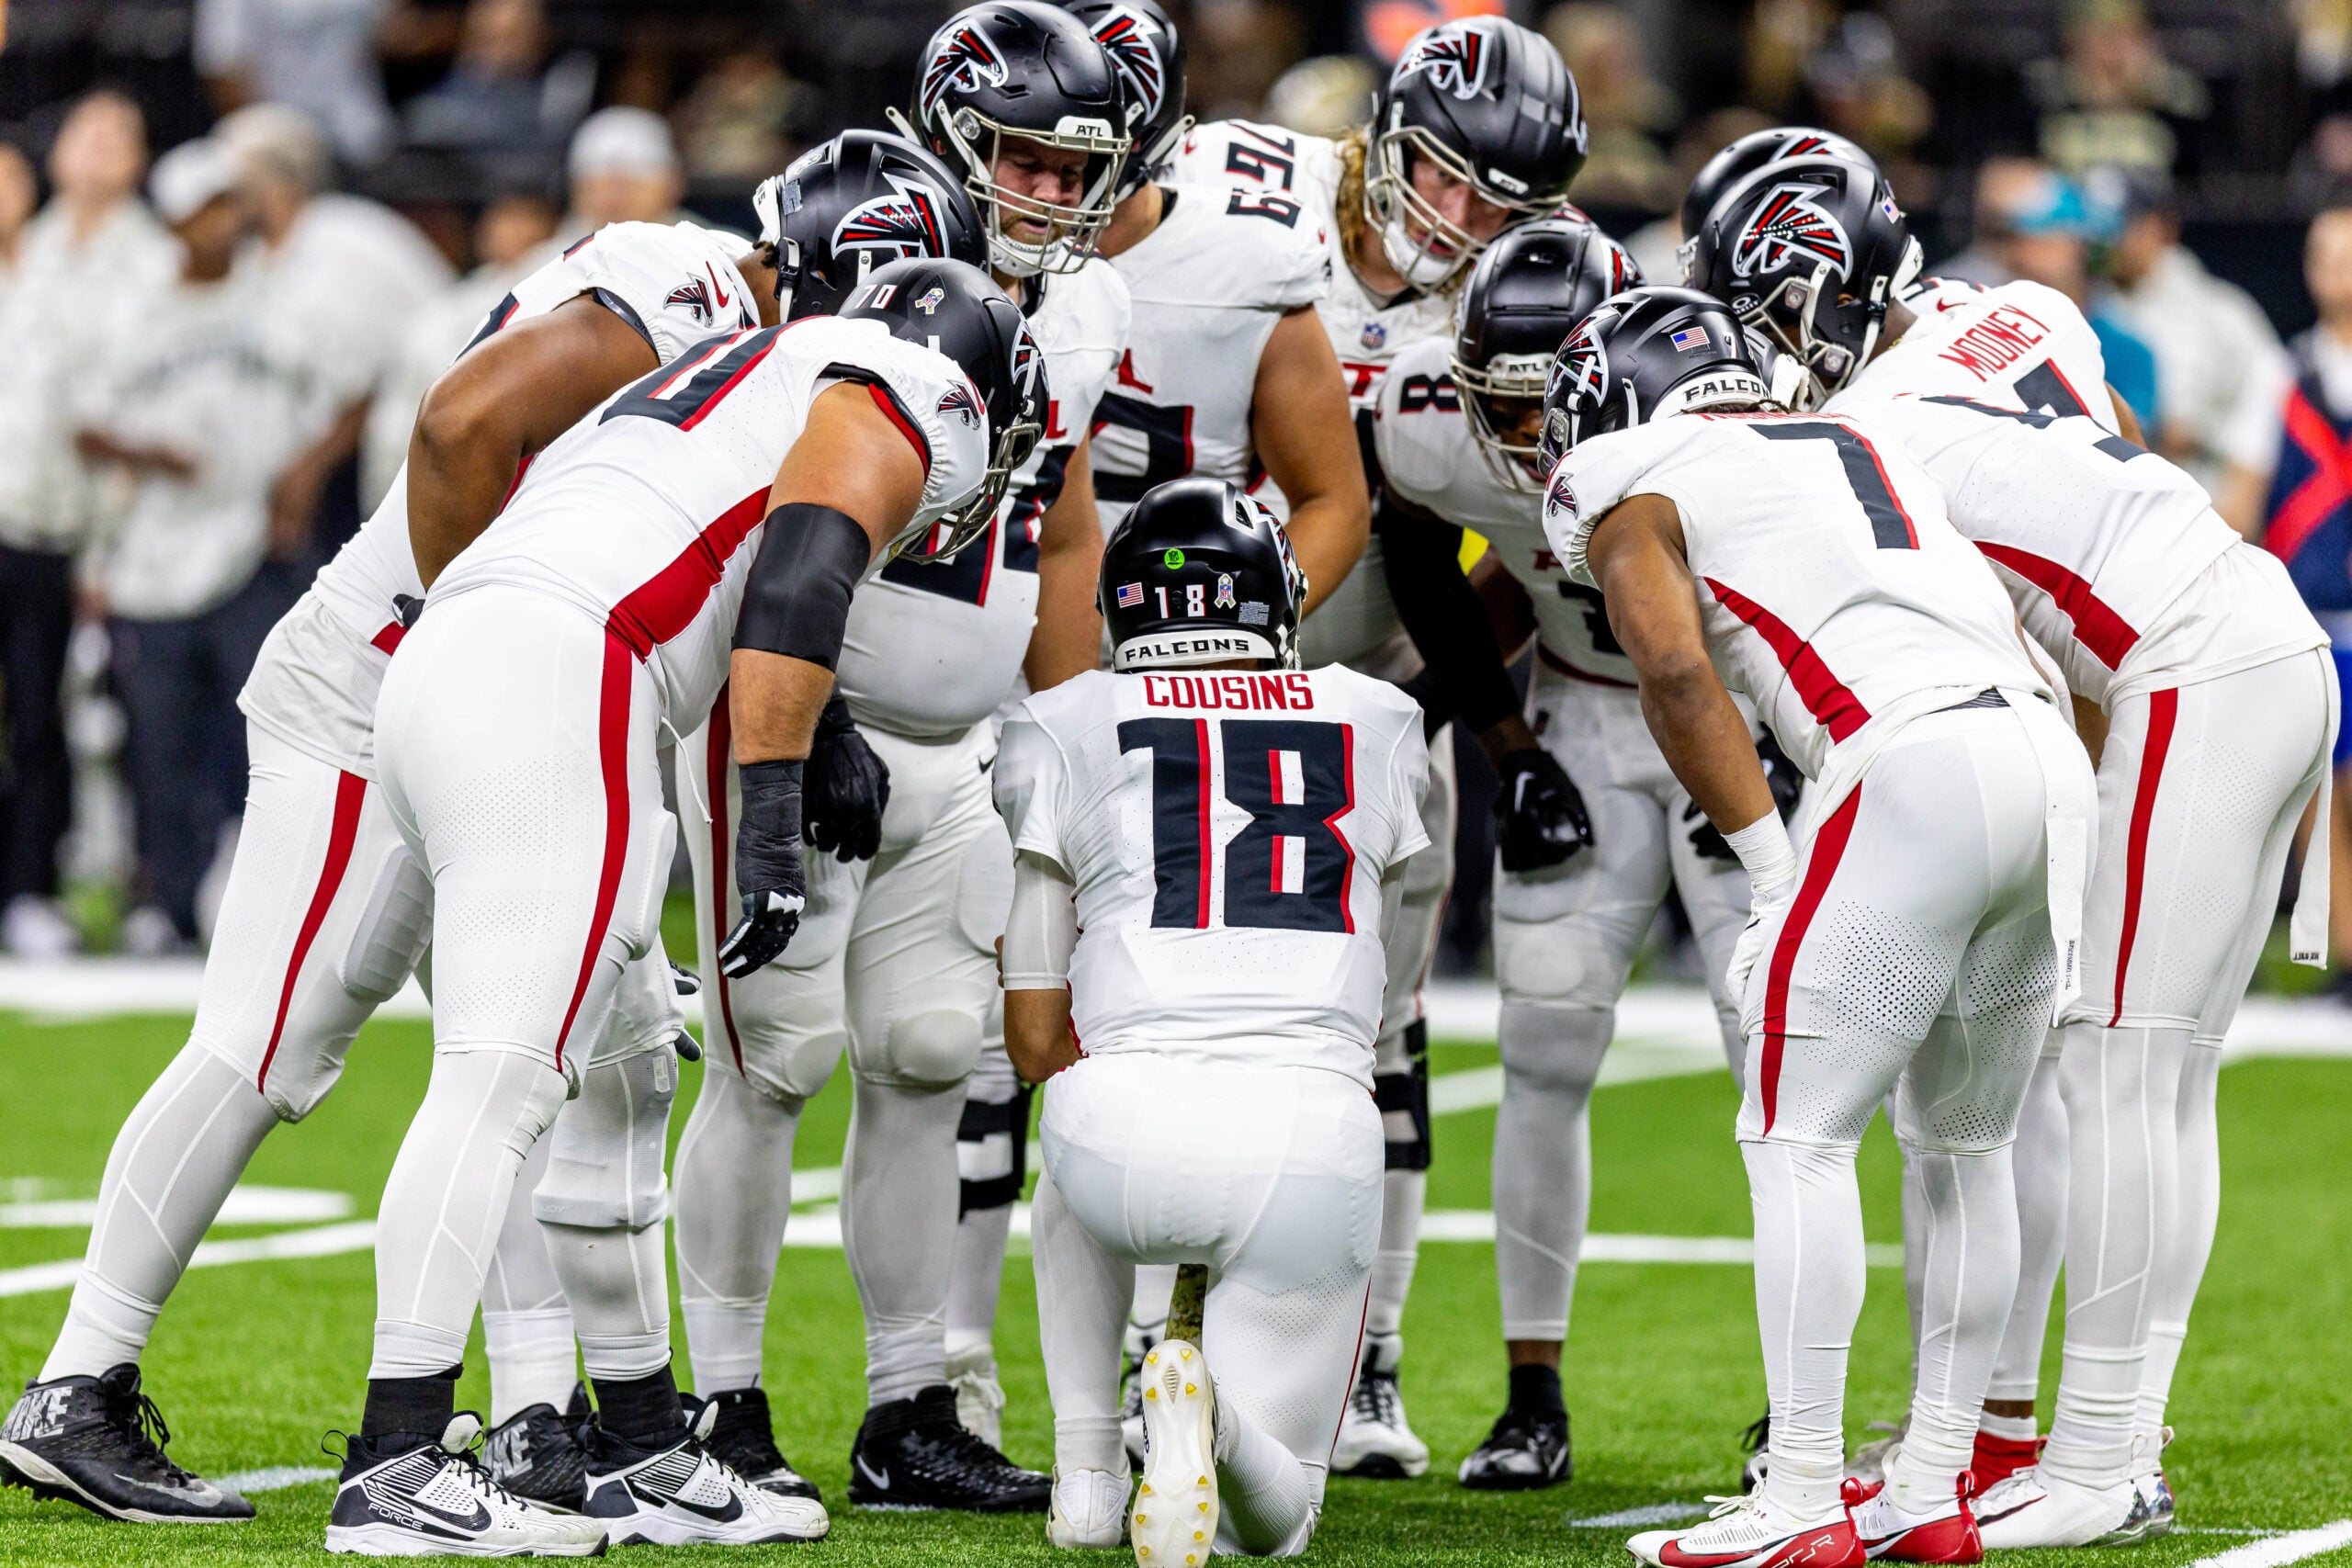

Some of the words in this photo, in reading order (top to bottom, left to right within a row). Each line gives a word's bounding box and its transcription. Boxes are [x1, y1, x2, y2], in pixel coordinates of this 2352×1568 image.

[1076, 124, 1103, 137] ATL
[854, 284, 899, 310] 70
[1938, 304, 2051, 382] MOONEY
[1508, 363, 1542, 373] ATL
[1683, 378, 1773, 402] FALCON
[1747, 422, 1920, 550] 7
[1125, 637, 1250, 662] FALCONS
[1143, 673, 1315, 710] COUSINS
[1116, 716, 1356, 935] 18
[368, 1502, 424, 1531] FORCE
